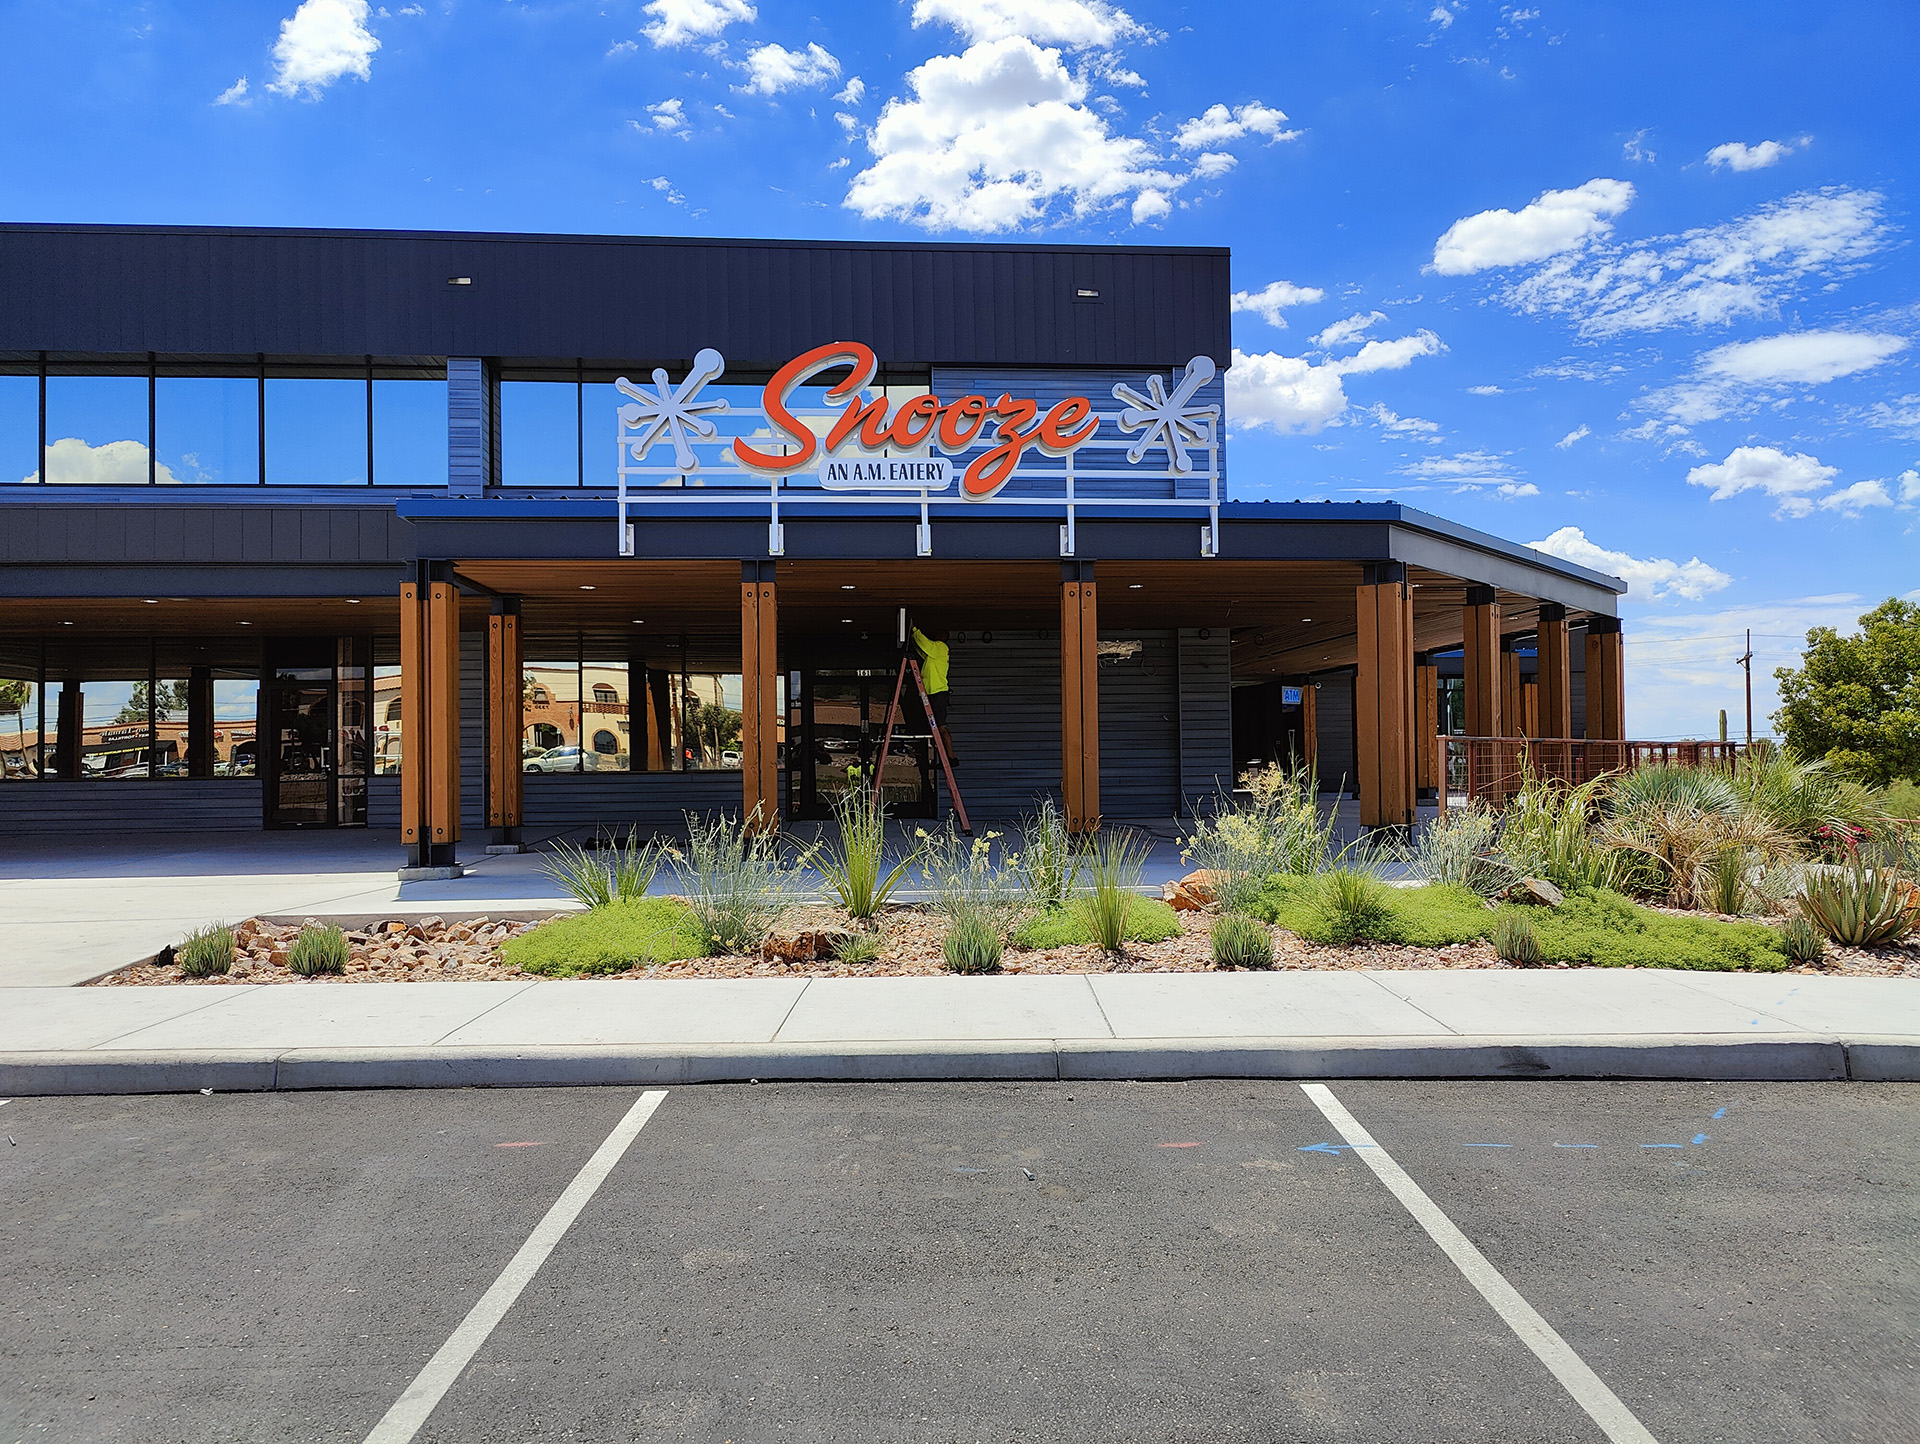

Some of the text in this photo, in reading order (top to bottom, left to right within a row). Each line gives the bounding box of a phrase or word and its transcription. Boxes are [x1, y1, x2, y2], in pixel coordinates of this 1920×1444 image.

[734, 341, 1098, 494] Snooze
[827, 463, 944, 480] AN A.M. EATERY
[1284, 688, 1300, 702] ATM
